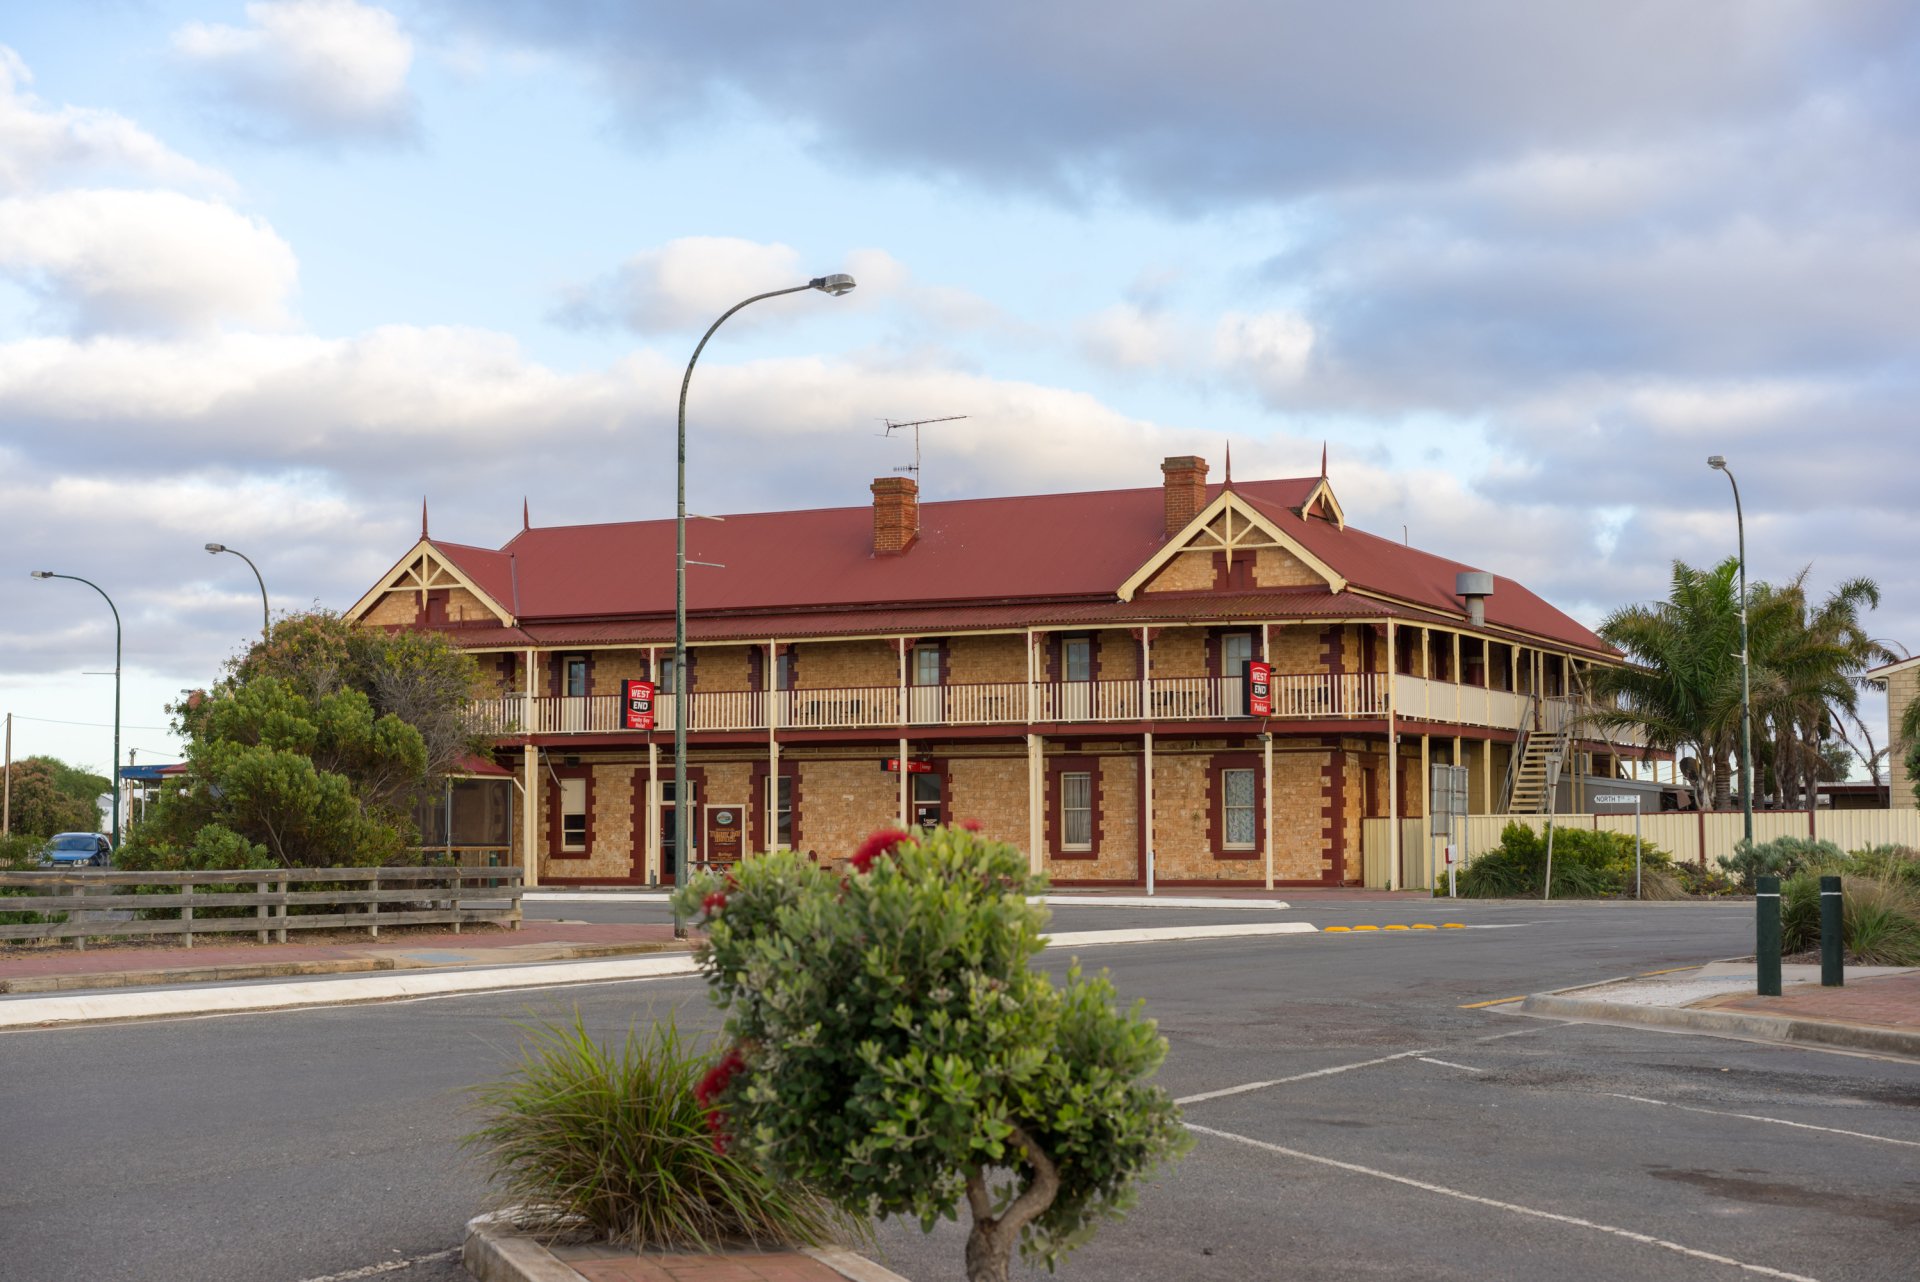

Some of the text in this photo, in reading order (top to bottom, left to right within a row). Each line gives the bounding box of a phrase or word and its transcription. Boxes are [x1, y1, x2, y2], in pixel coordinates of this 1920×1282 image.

[1252, 671, 1268, 682] WEST
[631, 689, 650, 698] WEST
[1254, 684, 1266, 694] END
[633, 700, 648, 710] END
[1596, 795, 1616, 803] NORTH
